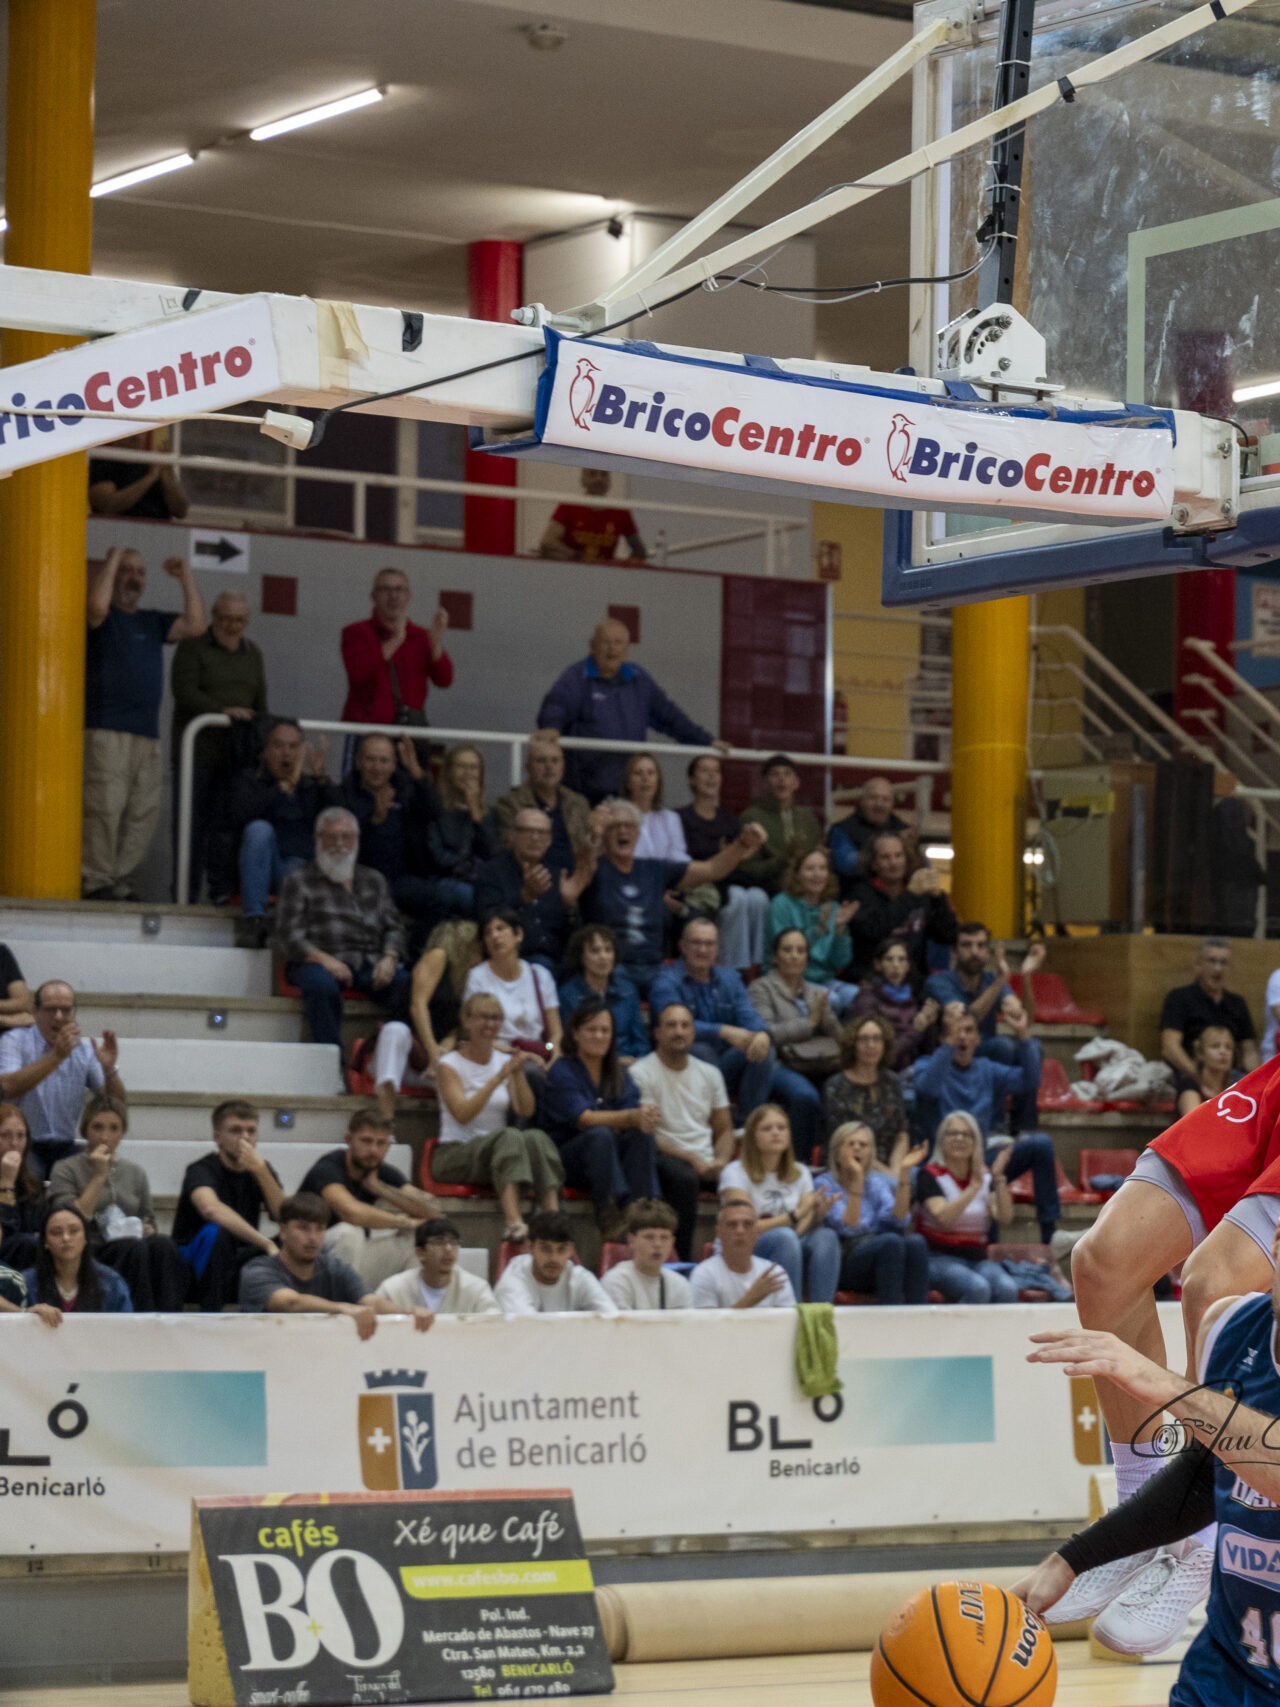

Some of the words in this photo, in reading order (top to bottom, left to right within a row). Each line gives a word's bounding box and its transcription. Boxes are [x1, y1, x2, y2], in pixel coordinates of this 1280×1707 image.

[592, 384, 862, 466] BricoCentro
[909, 437, 1155, 497] BricoCentro
[453, 1390, 641, 1432] Ajuntament
[456, 1437, 496, 1469] de
[507, 1432, 647, 1467] Benicarló
[769, 1457, 860, 1477] Benicarló
[0, 1476, 106, 1496] Benicarló
[258, 1519, 339, 1557] cafés
[394, 1516, 438, 1547] Xé
[441, 1523, 498, 1559] que
[503, 1510, 565, 1558] Café
[413, 1570, 557, 1588] www.cafesbo.com
[480, 1609, 505, 1622] Pol.
[506, 1607, 530, 1621] Ind.
[422, 1628, 476, 1643] Mercado
[478, 1627, 492, 1640] de
[494, 1626, 541, 1640] Abastos
[548, 1625, 580, 1638] Nave
[441, 1648, 472, 1661] Ctra.
[475, 1647, 497, 1660] San
[540, 1644, 565, 1657] Km.
[461, 1666, 496, 1682] 12580
[501, 1659, 575, 1677] BENICARLÓ
